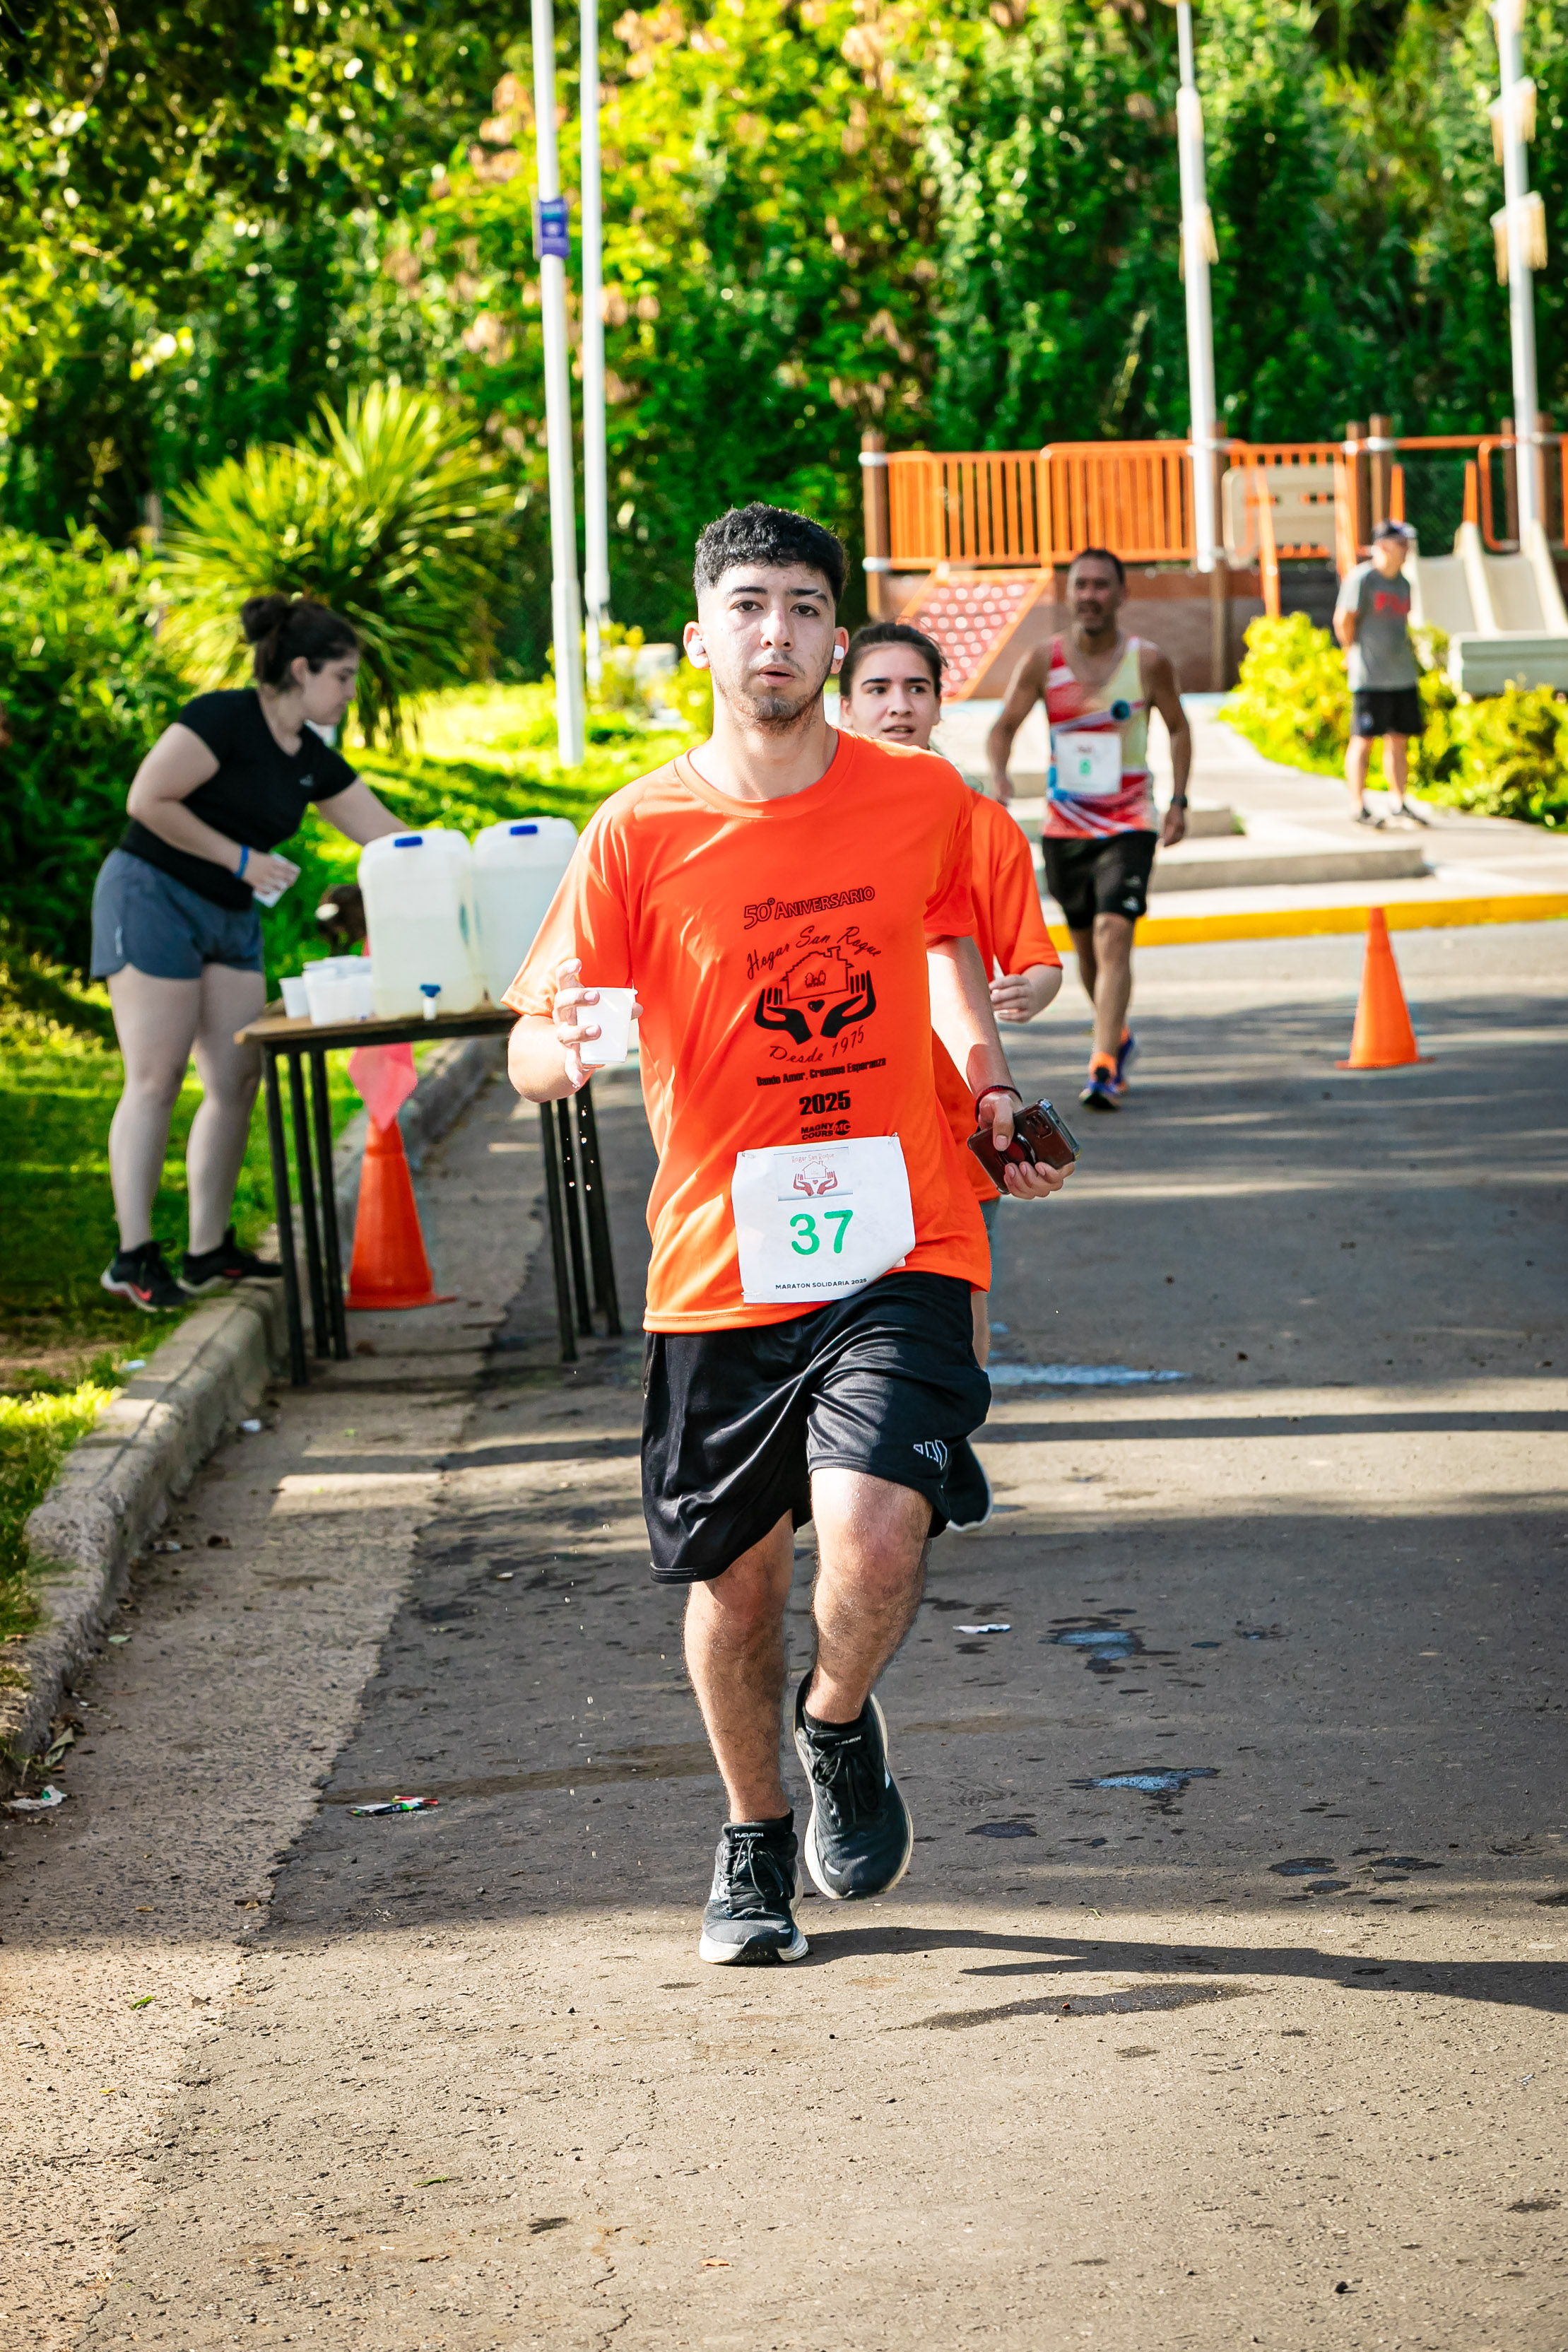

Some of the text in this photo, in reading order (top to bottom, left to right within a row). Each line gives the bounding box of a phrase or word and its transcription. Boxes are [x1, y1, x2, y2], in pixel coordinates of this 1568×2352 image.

[747, 925, 882, 980] Hogar San Roque
[770, 1025, 863, 1063] Desde 1975
[756, 1075, 781, 1086] Dando
[810, 1065, 845, 1079] Creamos
[847, 1057, 886, 1074] Esperanza
[799, 1090, 851, 1115] 2025
[801, 1122, 834, 1134] MAGNY
[801, 1130, 833, 1140] COURS
[789, 1209, 854, 1255] 37
